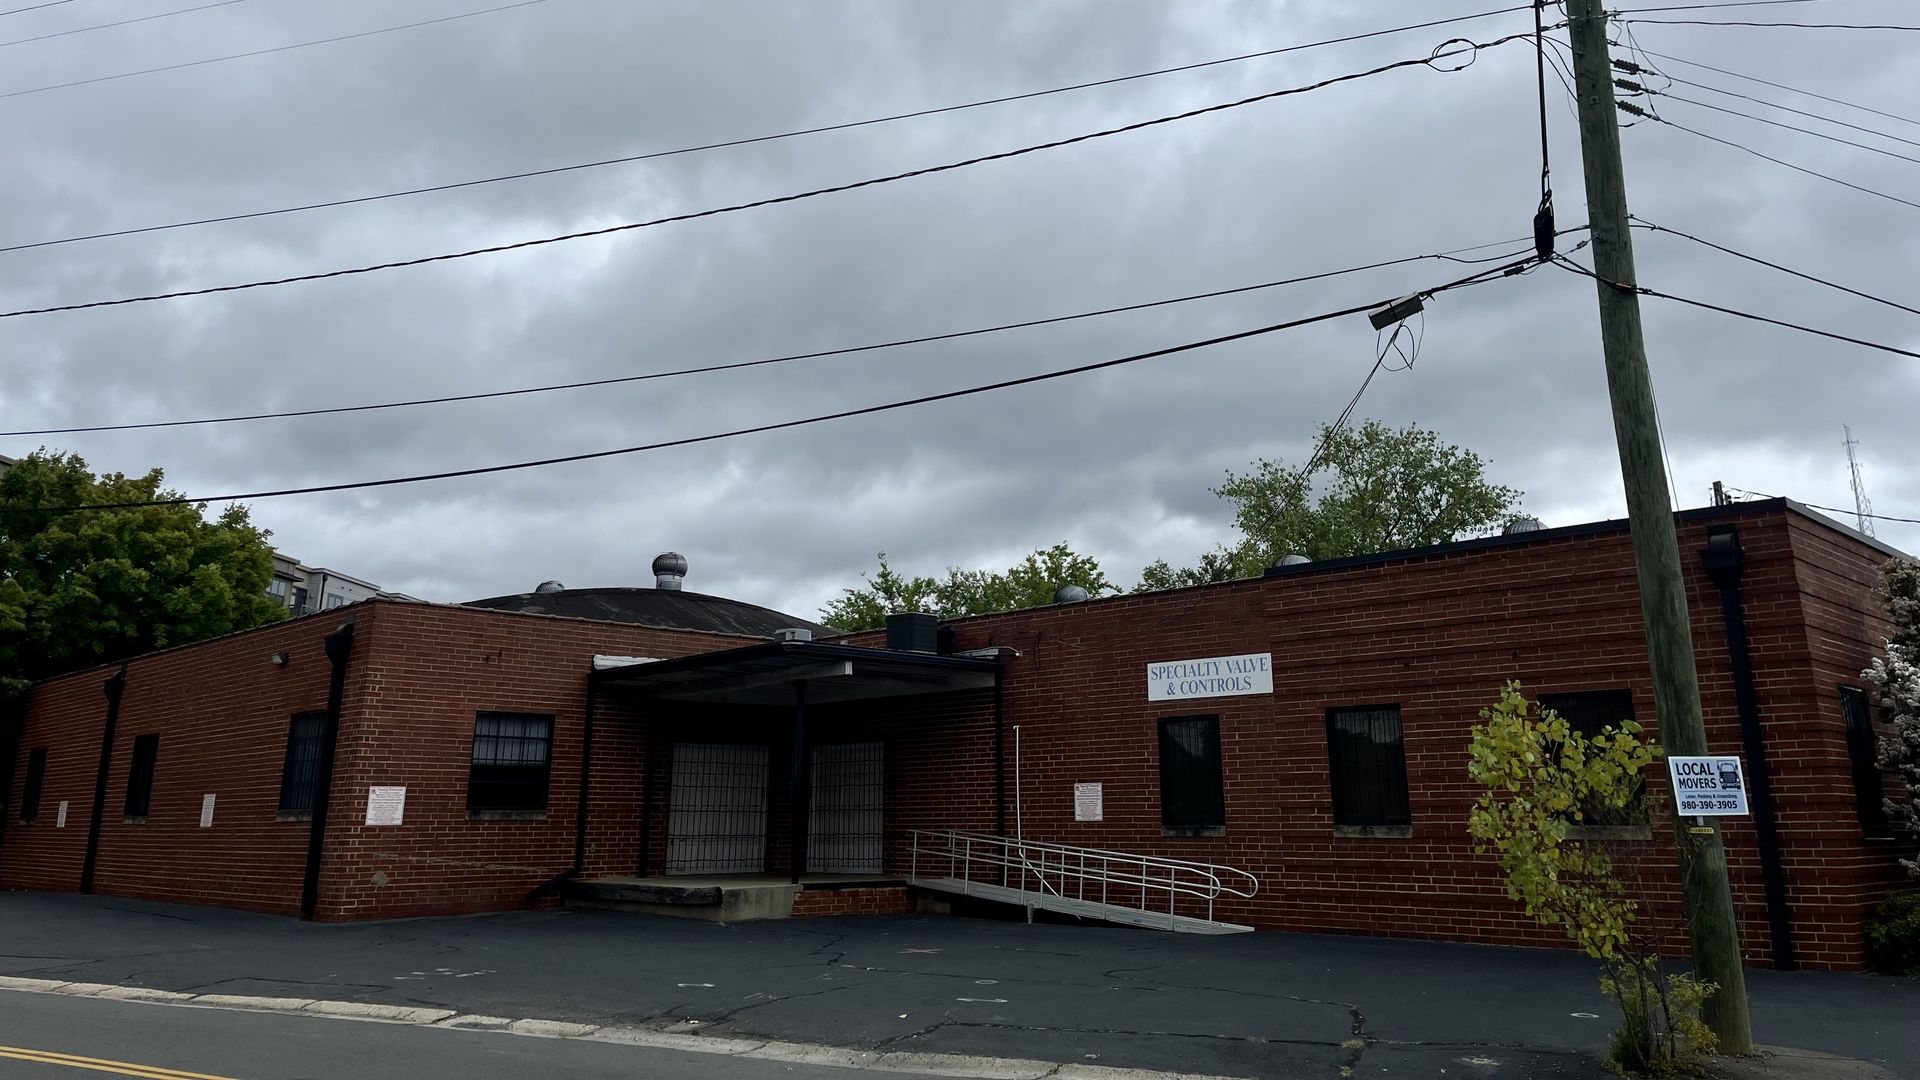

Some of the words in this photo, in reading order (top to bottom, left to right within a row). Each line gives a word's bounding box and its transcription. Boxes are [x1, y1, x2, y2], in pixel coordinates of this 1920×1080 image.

[1151, 661, 1221, 680] SPECIALTY
[1226, 657, 1269, 674] VALVE
[1167, 682, 1176, 695] &
[1180, 676, 1252, 695] CONTROLS
[1675, 763, 1715, 776] LOCAL
[1678, 778, 1717, 789] MOVERS
[1681, 801, 1738, 809] 980-390-3905
